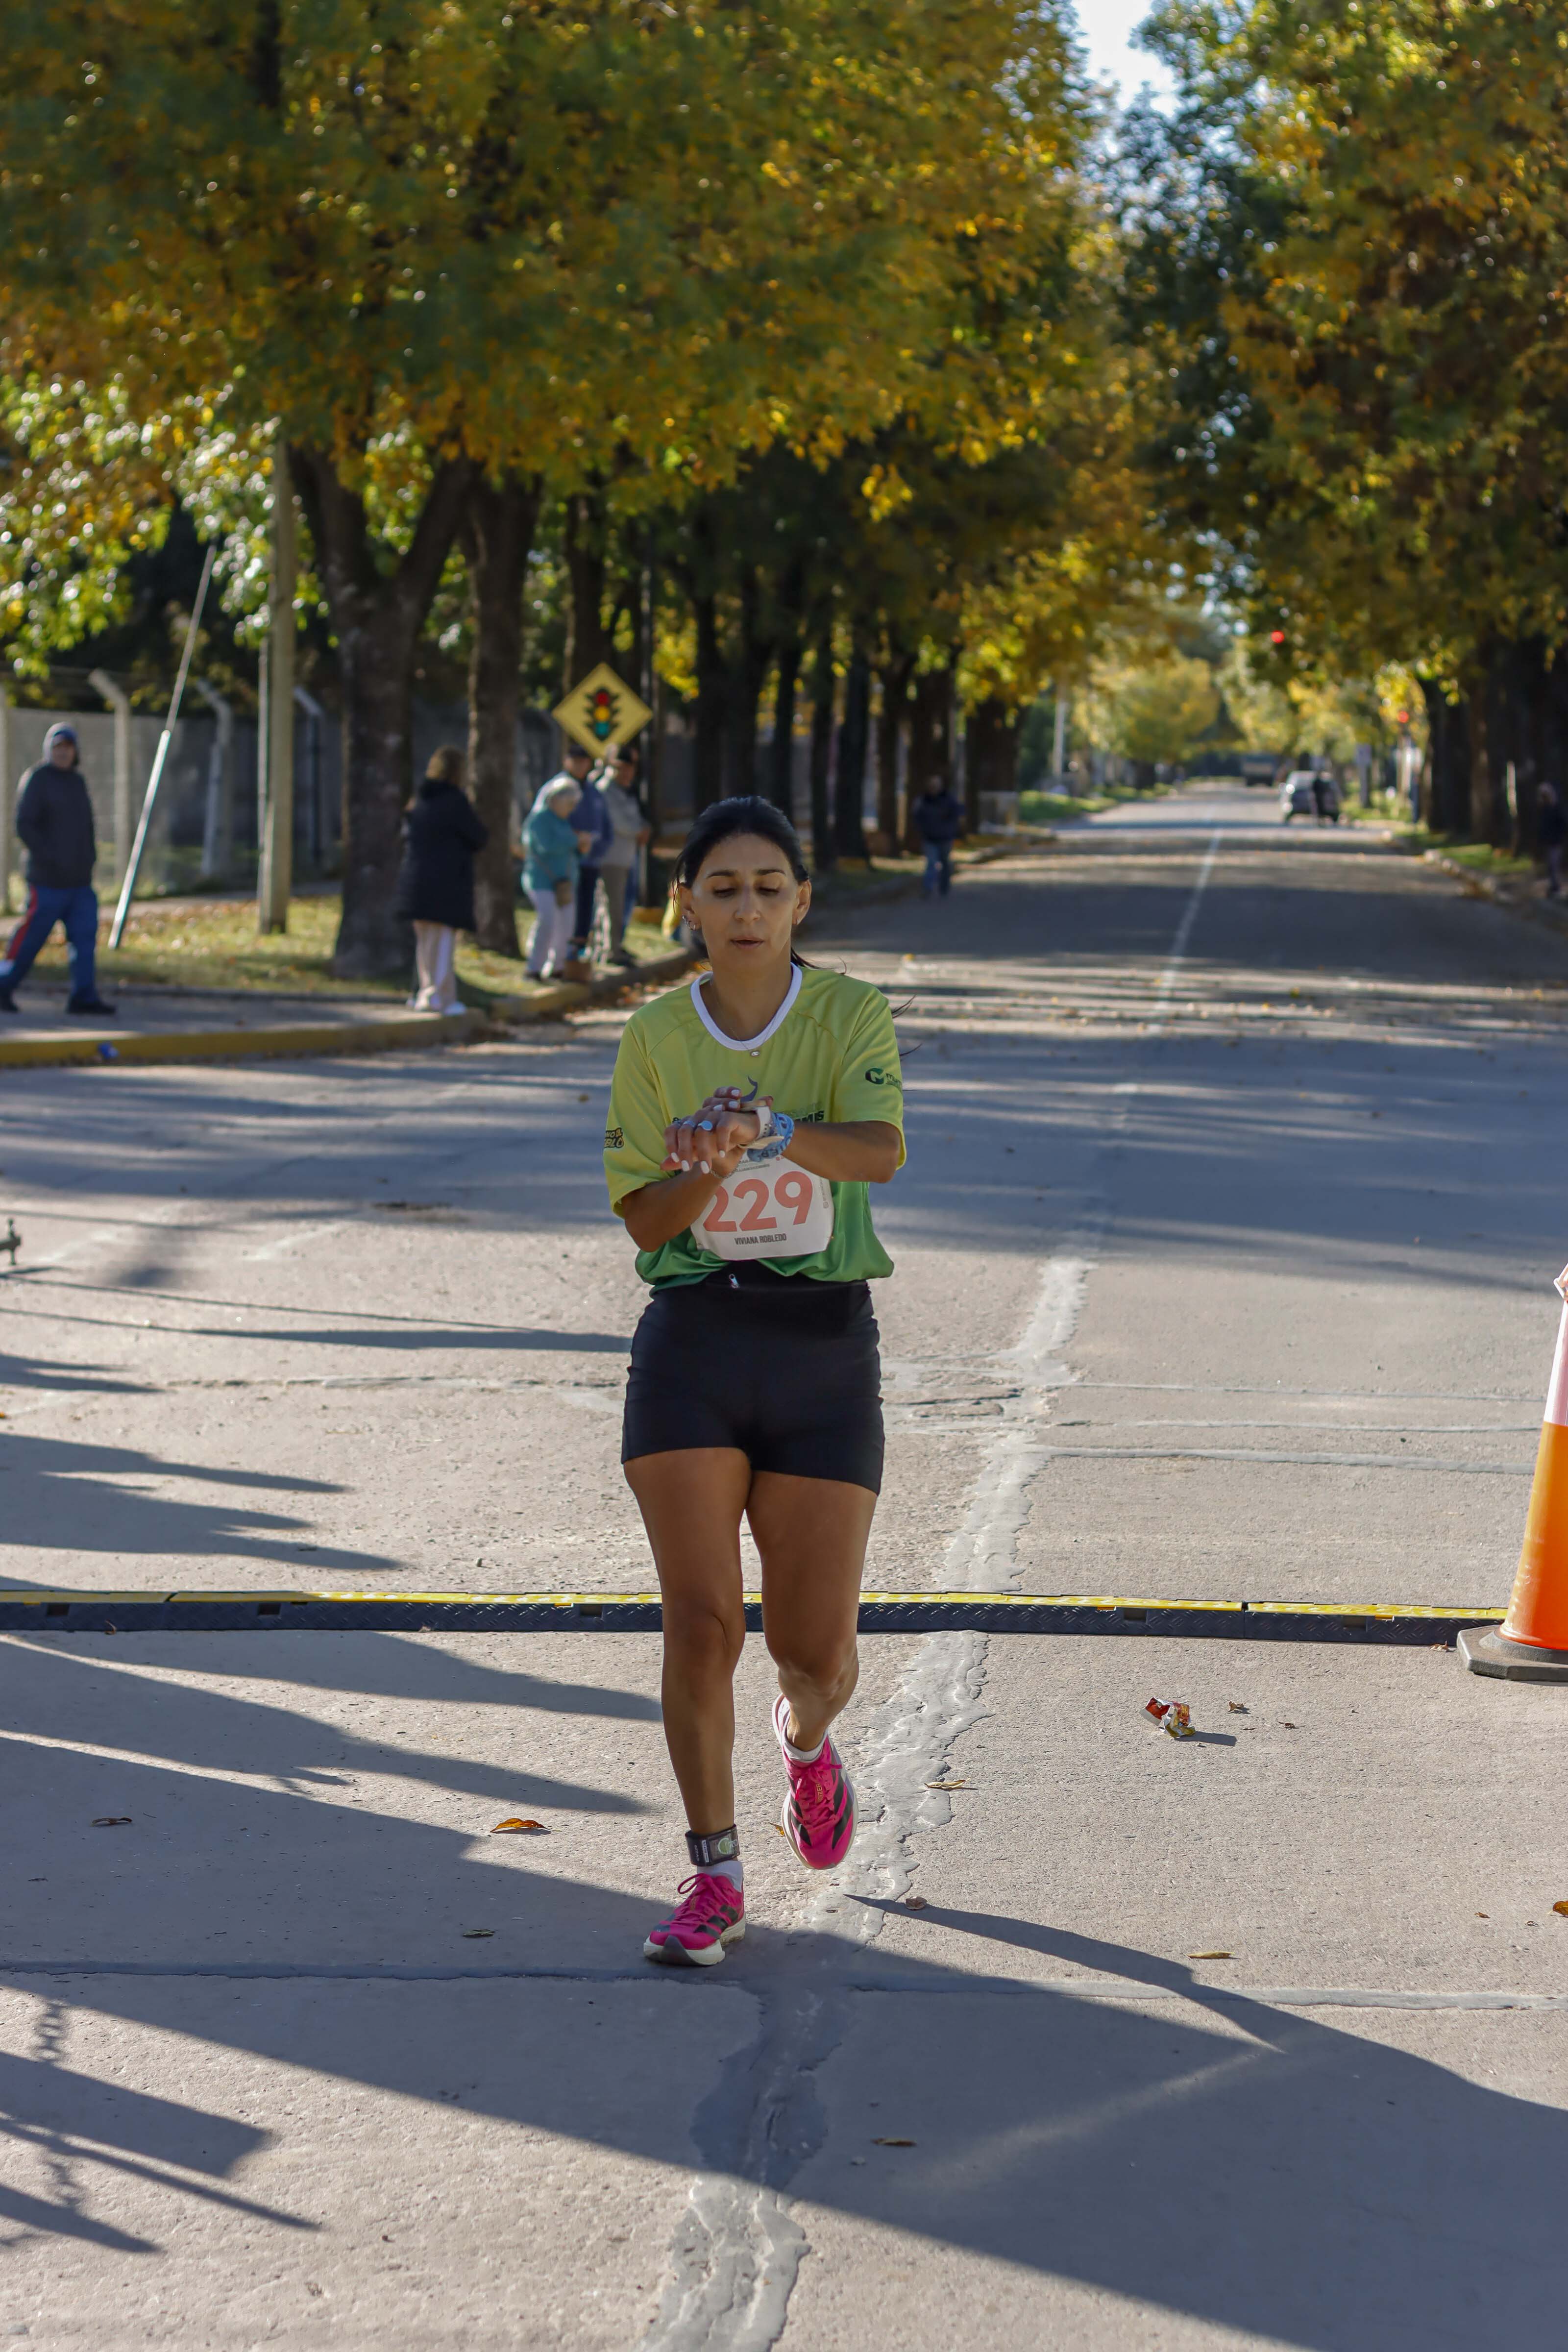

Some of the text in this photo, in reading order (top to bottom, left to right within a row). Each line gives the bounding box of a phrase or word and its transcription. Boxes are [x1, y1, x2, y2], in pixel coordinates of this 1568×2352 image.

[703, 1171, 813, 1232] 229
[735, 1233, 787, 1245] VIVIANA ROBLEDO
